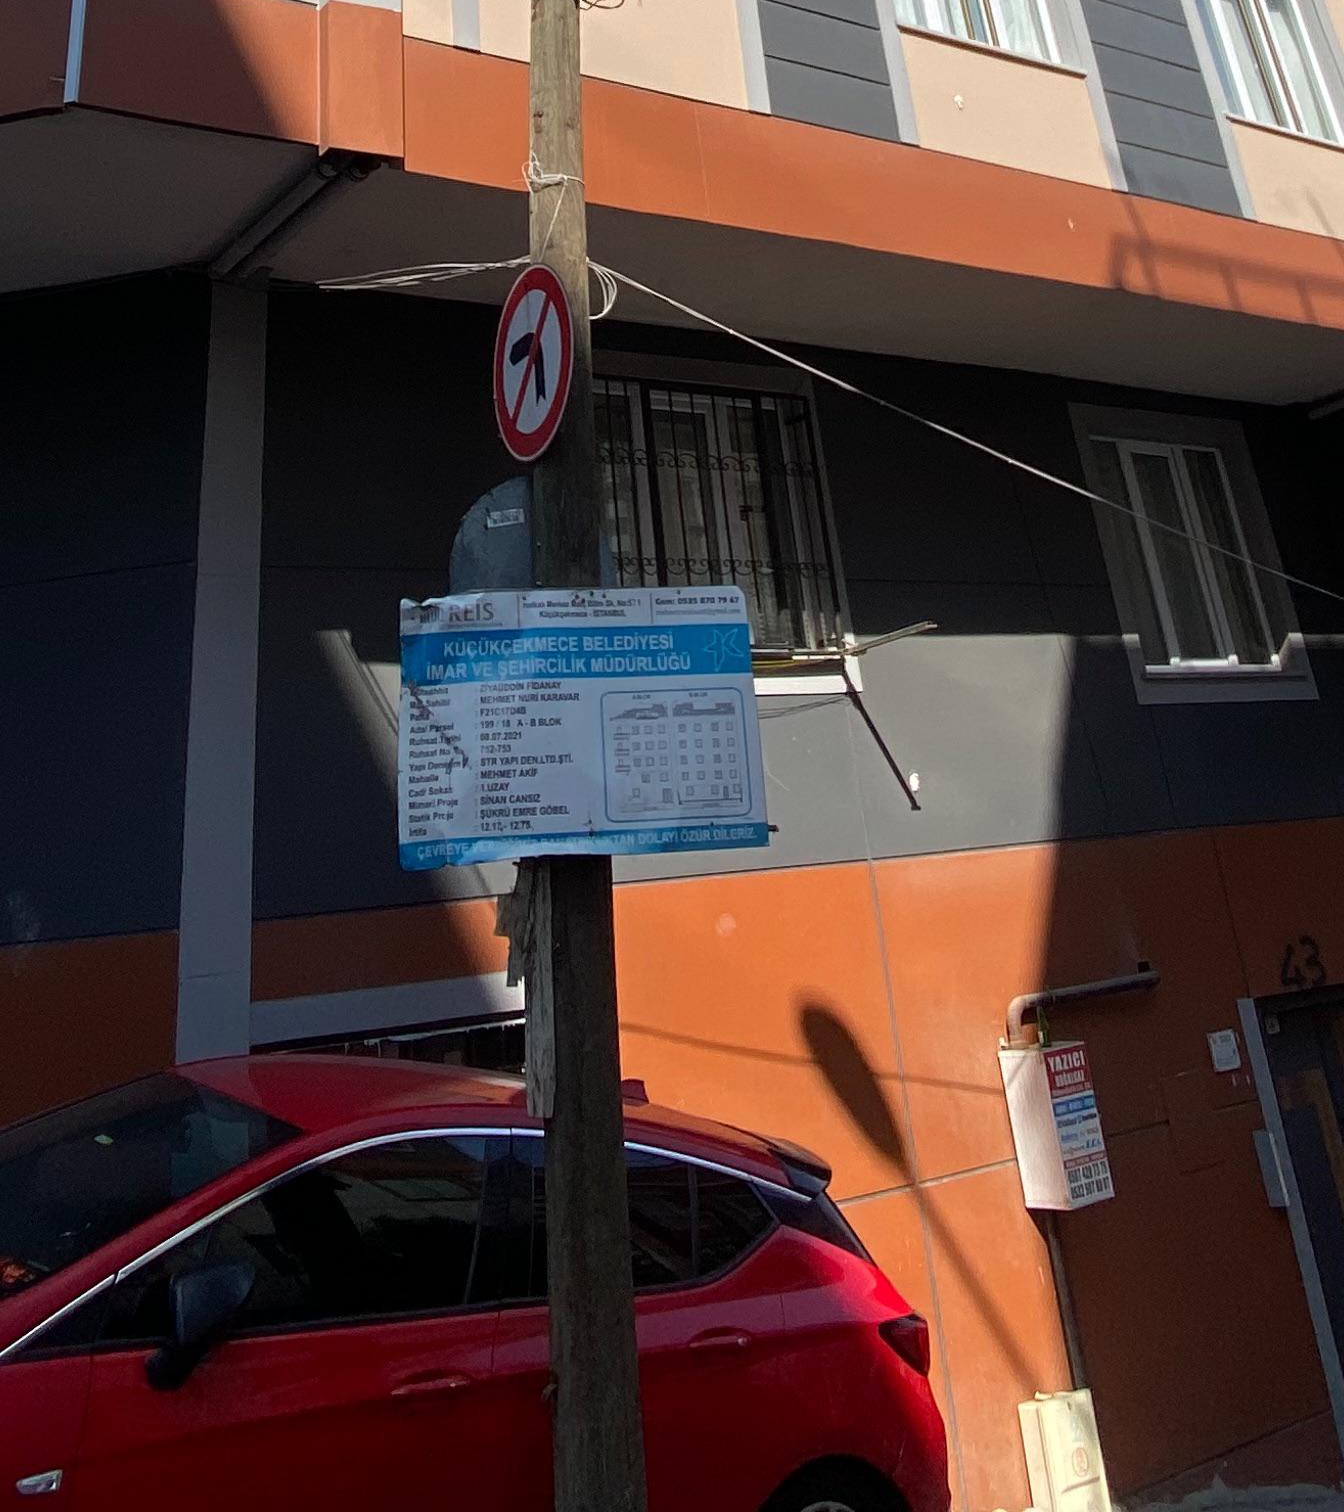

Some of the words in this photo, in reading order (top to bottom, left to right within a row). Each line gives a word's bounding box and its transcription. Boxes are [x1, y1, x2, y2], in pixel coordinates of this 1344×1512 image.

[443, 636, 579, 658] KÜÇÜKÇEKMECE
[583, 630, 674, 652] BELEDİYESİ
[426, 662, 467, 680] İMAR
[471, 660, 495, 676] VE
[497, 654, 587, 680] ŞEHİRCİLİK
[590, 652, 691, 673] MÜDÜRLÜĞÜ
[480, 768, 517, 779] MEHMET
[512, 806, 537, 817] EMRE
[681, 828, 711, 842] ÖZÜR
[1280, 936, 1327, 986] 43
[1047, 1050, 1086, 1073] YAZICI
